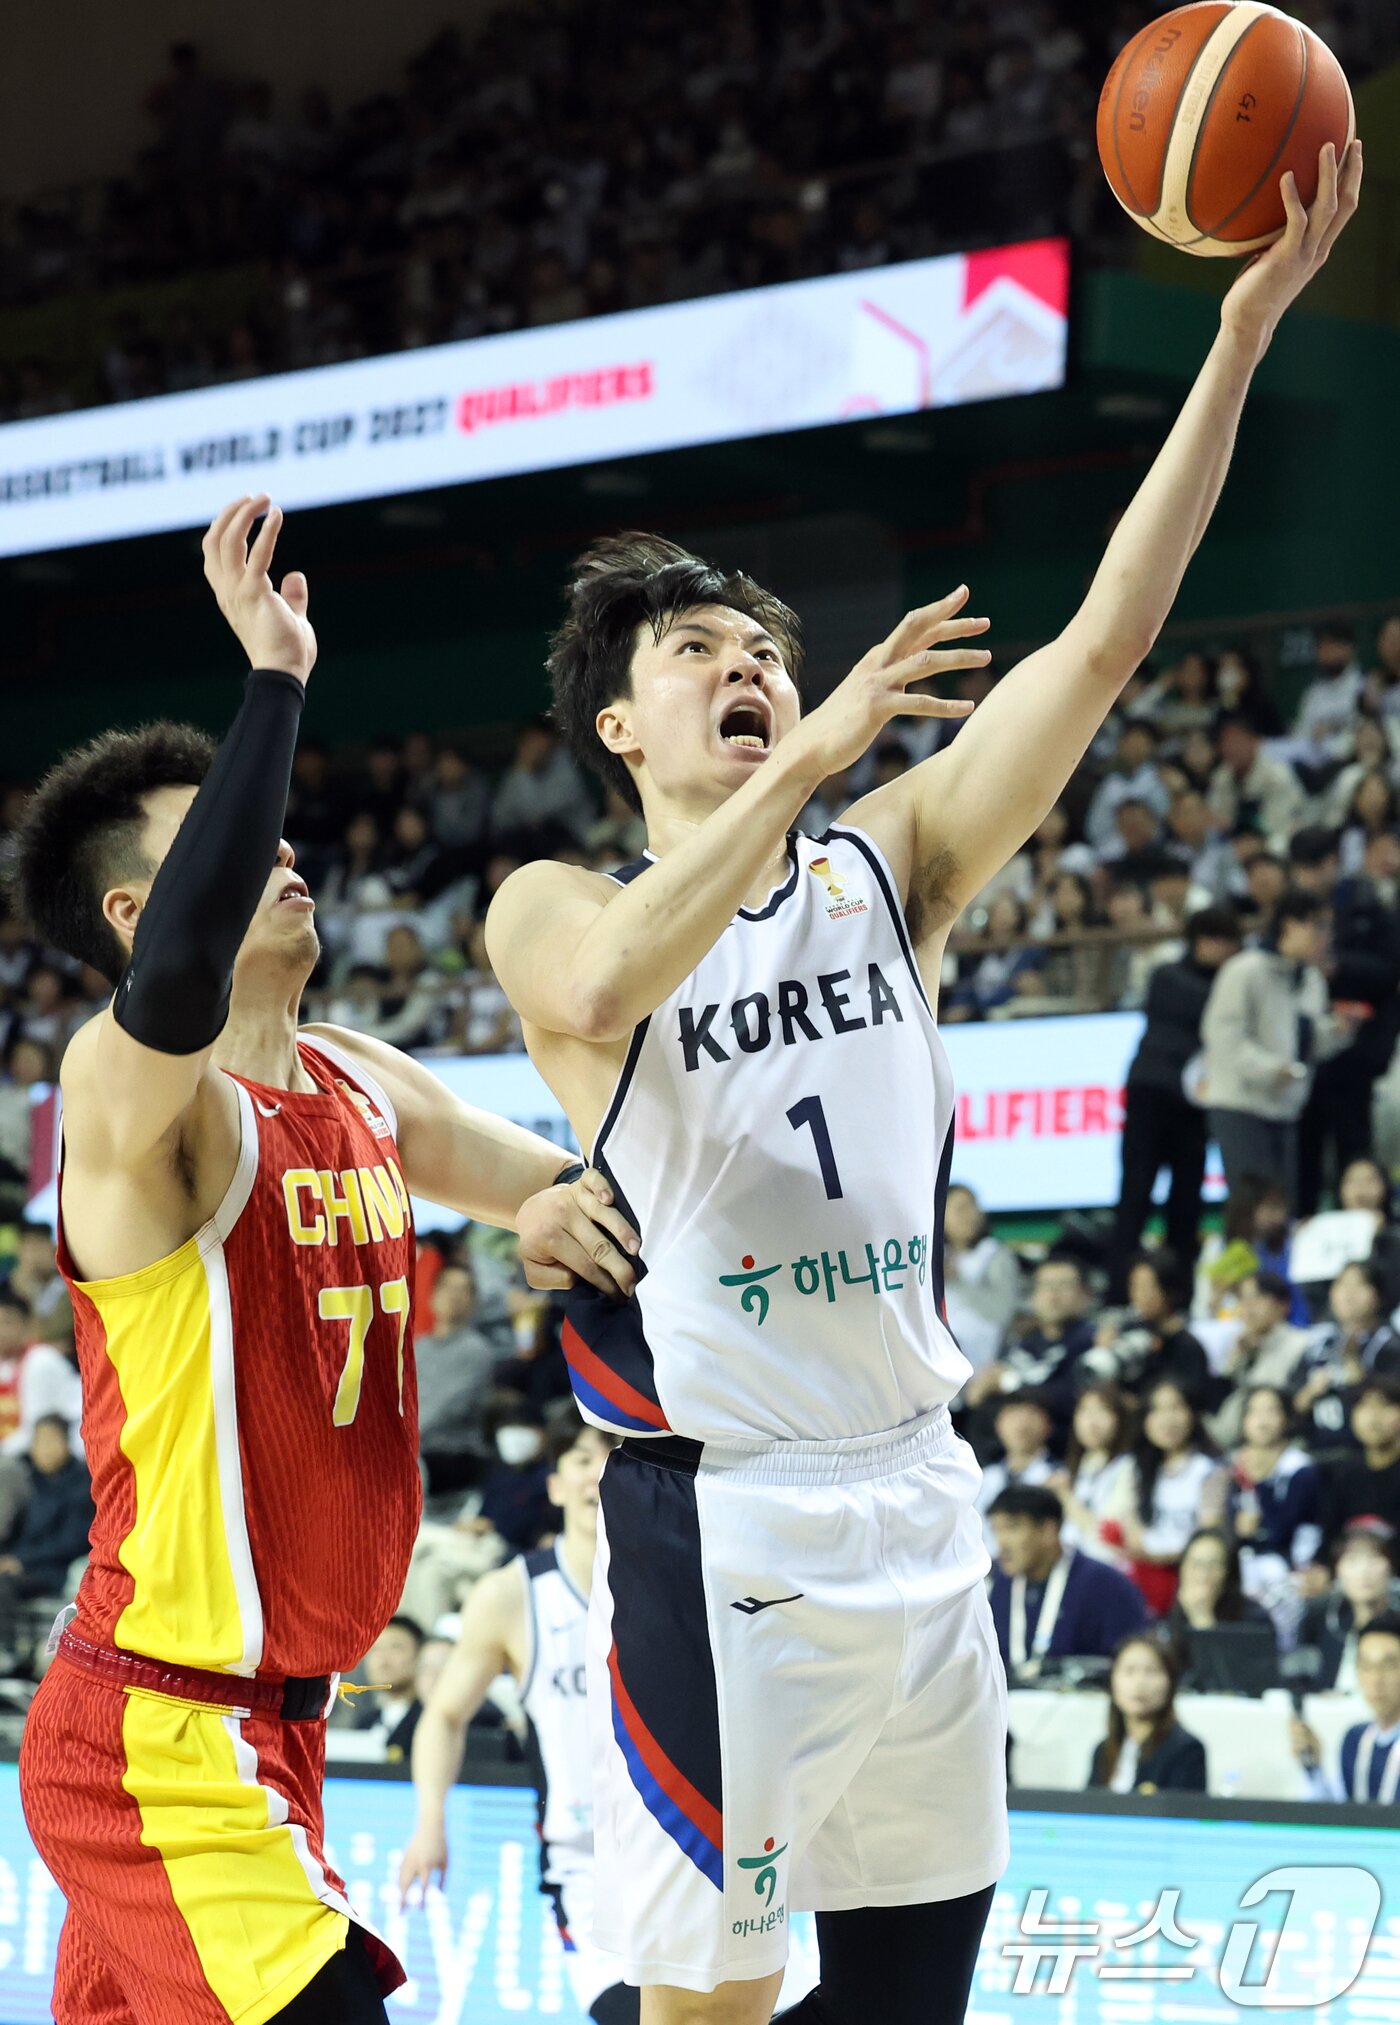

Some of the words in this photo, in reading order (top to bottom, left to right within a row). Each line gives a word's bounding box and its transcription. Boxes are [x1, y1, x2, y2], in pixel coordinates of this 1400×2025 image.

[0, 447, 165, 505] ASKETBALL
[180, 426, 281, 473] WORLD
[294, 409, 355, 454] CUP
[457, 361, 655, 436] QUALIFIERS
[826, 904, 850, 913] WORLD
[851, 899, 864, 907] CUP
[829, 904, 868, 920] QUALIFIERS
[678, 962, 904, 1072] KOREA
[786, 1095, 843, 1200] 1
[954, 1085, 1127, 1142] LIFIERS
[791, 1234, 928, 1303] 하나은행
[318, 1274, 410, 1427] 77
[732, 1903, 784, 1938] 하나은행
